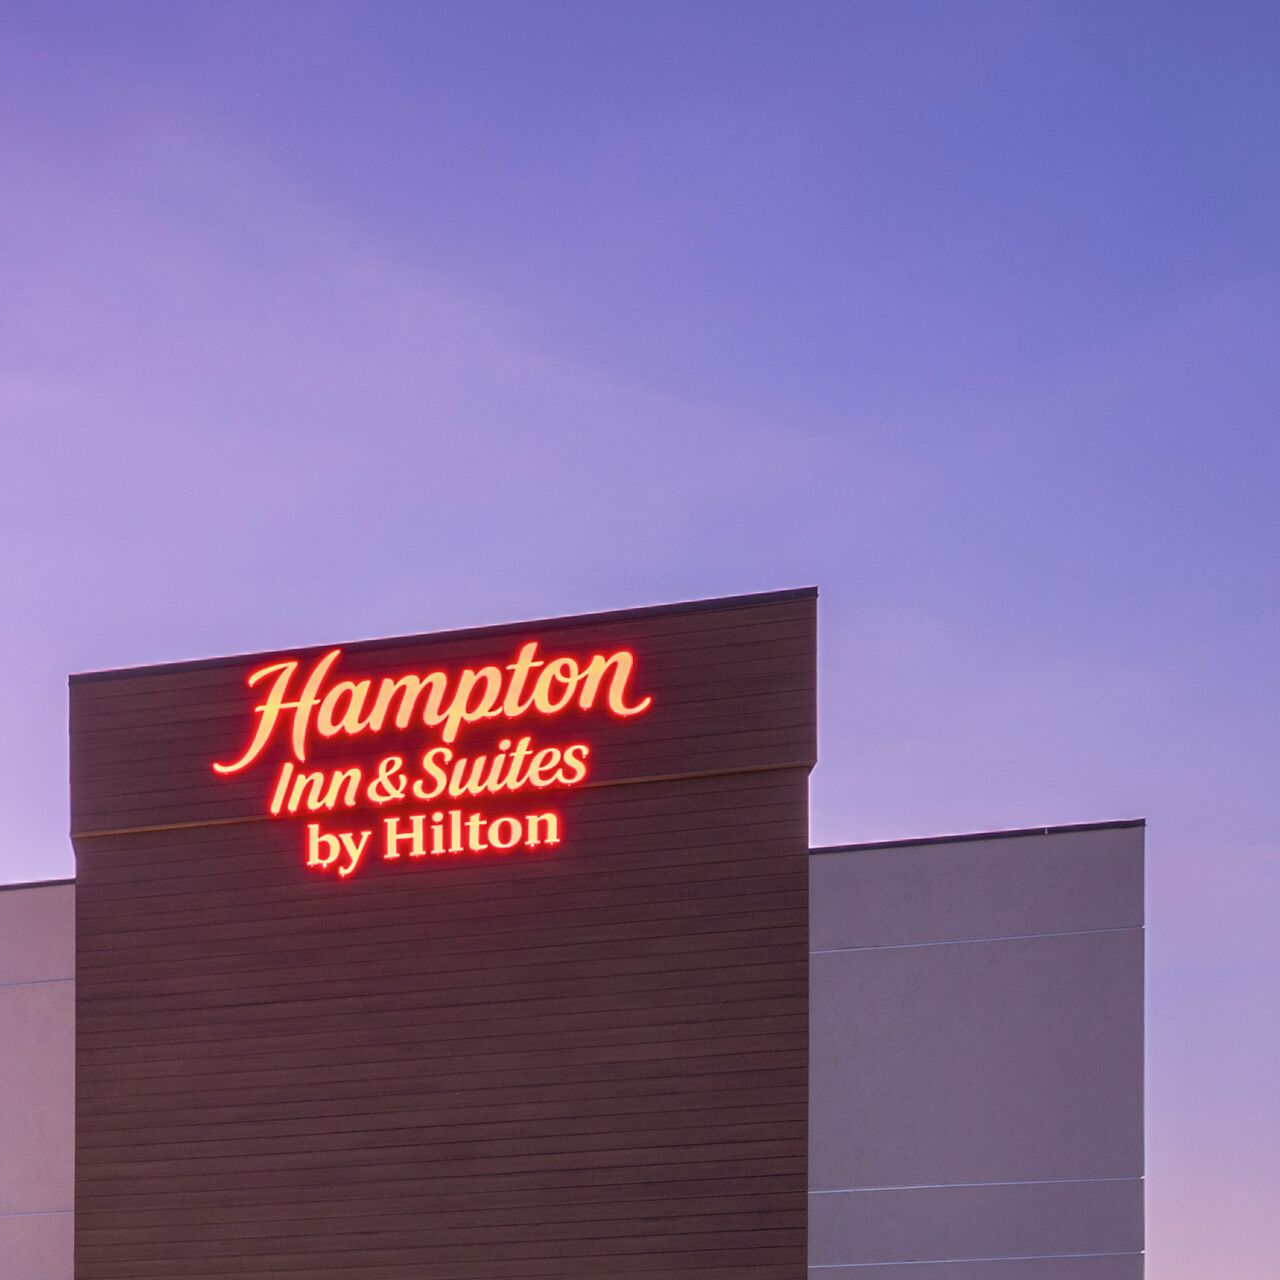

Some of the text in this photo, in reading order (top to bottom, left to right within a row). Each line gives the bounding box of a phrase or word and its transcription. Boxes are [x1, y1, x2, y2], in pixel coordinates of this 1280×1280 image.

[212, 642, 651, 774] Hampton
[306, 809, 561, 878] by Hilton
